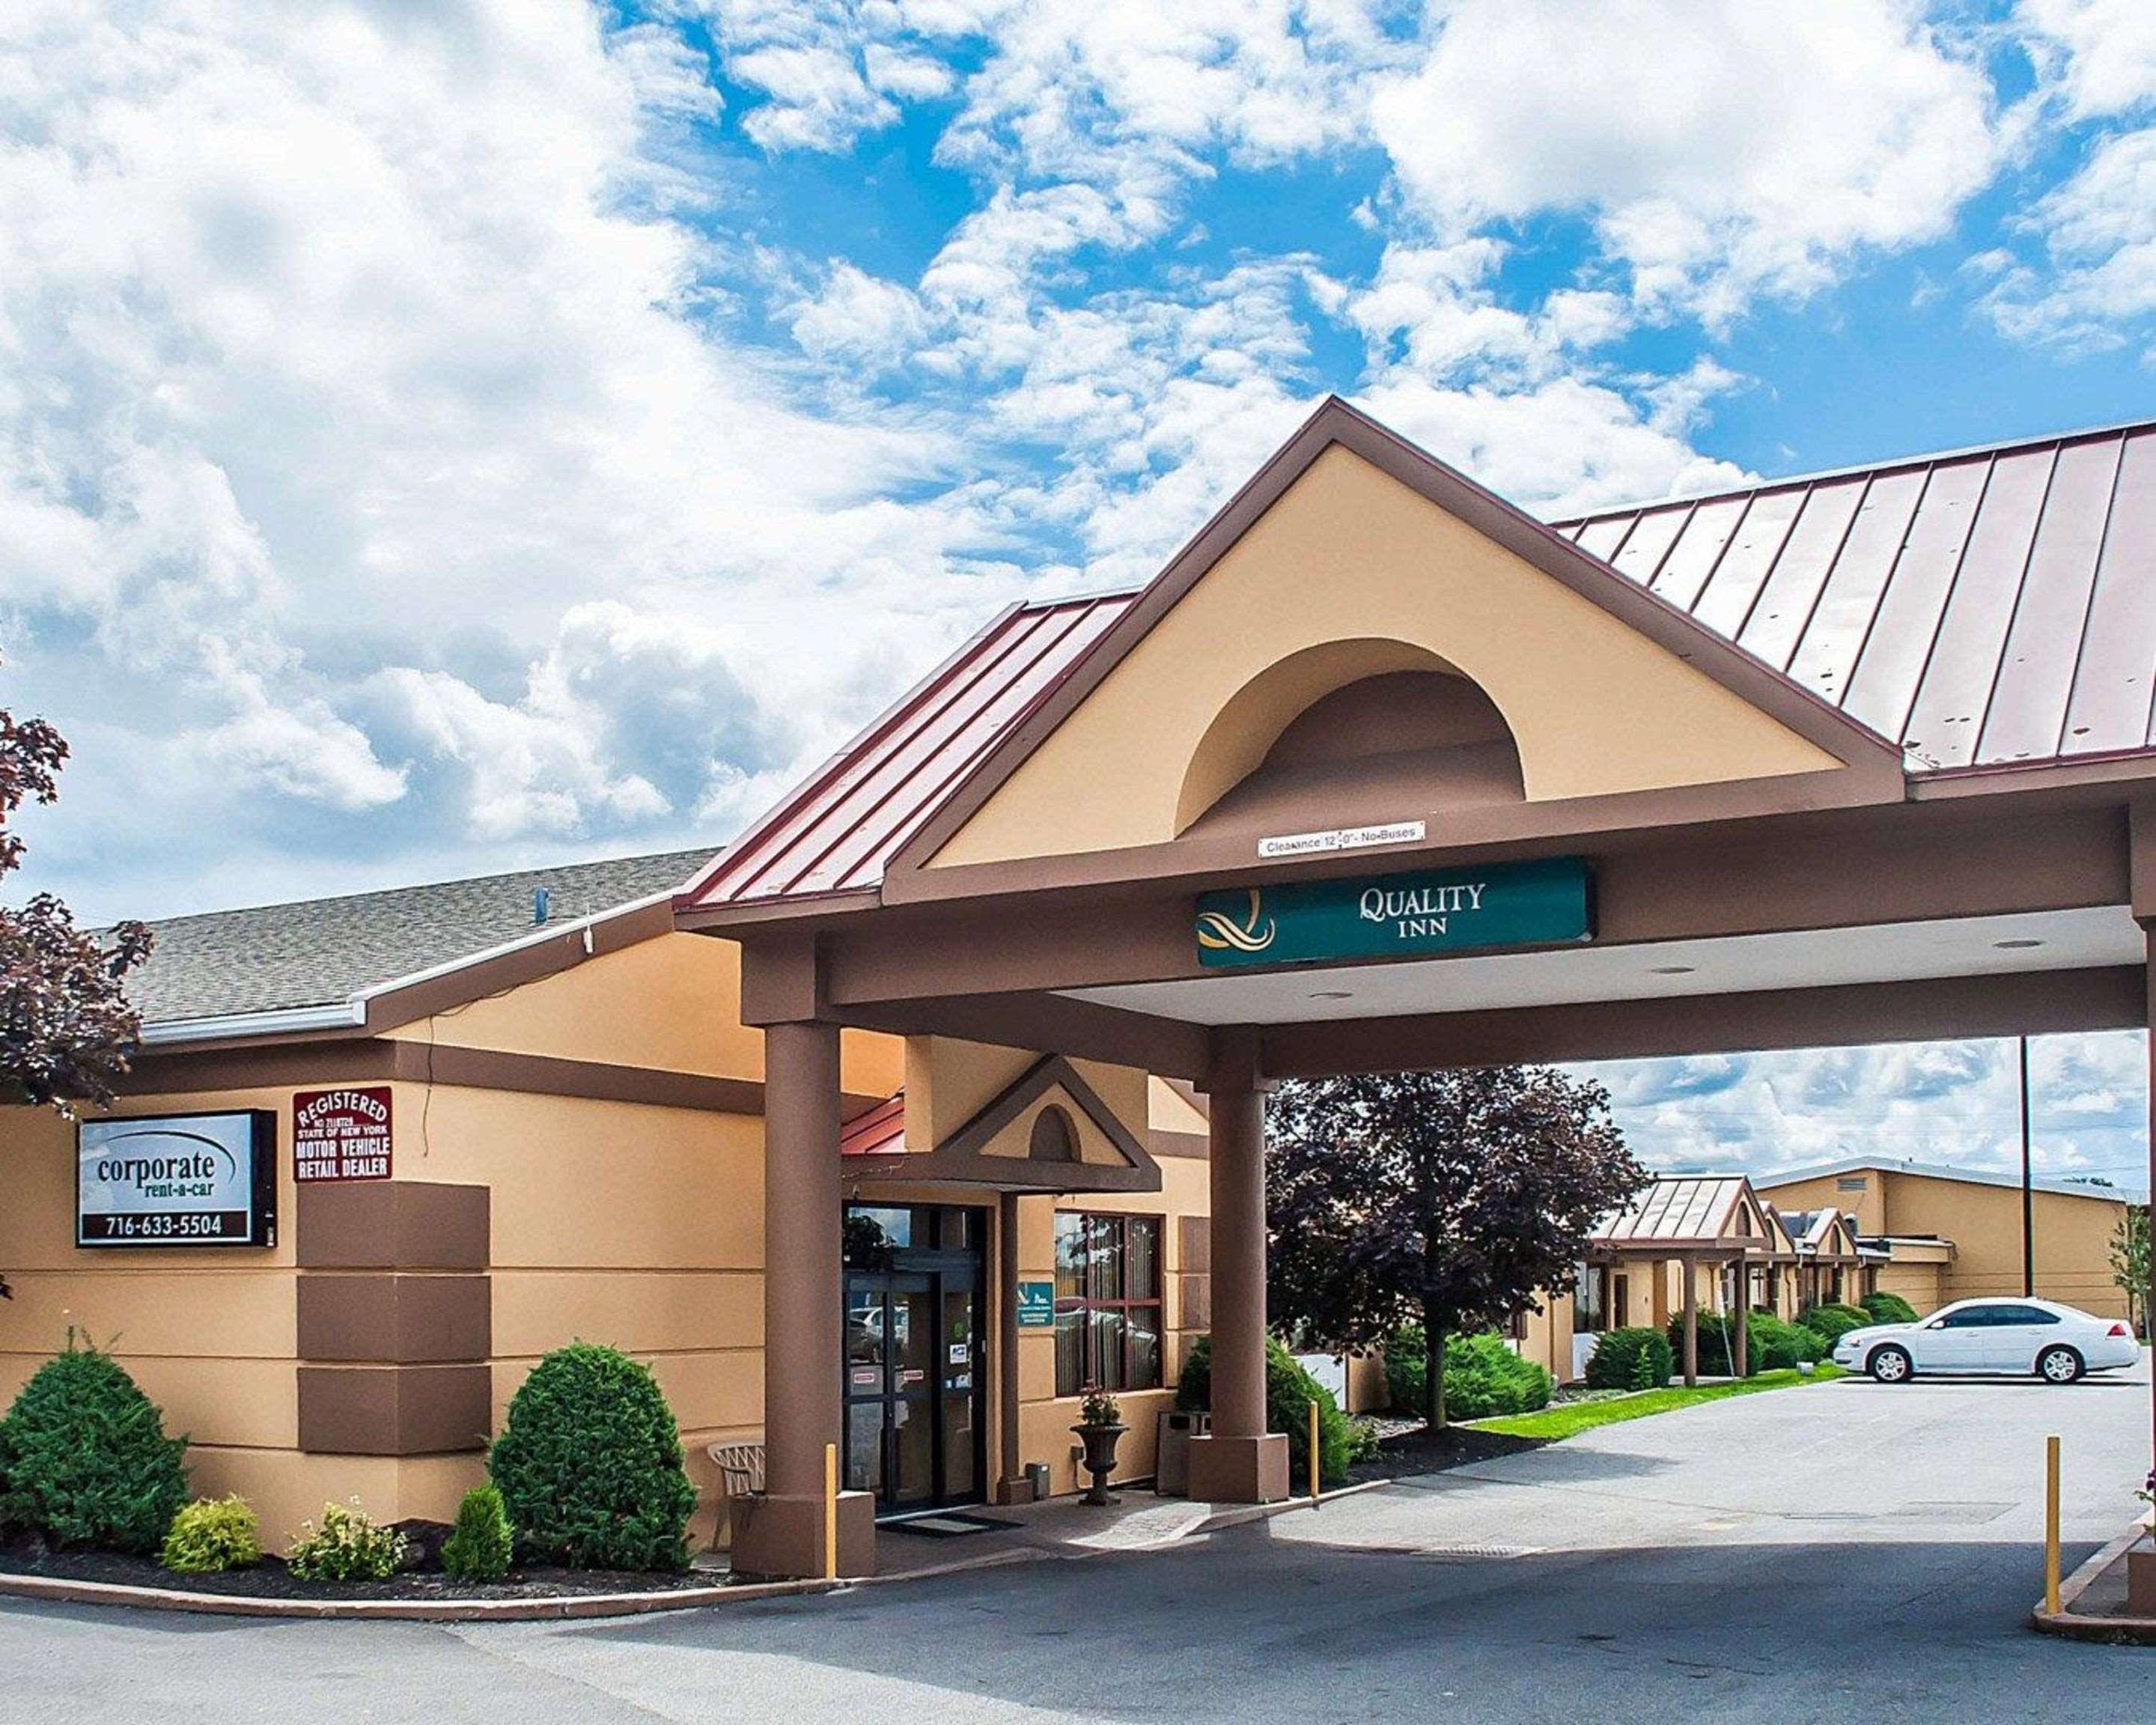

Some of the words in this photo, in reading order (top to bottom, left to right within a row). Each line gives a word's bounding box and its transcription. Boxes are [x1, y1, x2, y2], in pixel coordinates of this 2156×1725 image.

[1359, 883, 1486, 922] QUALITY
[1398, 918, 1447, 937] INN
[297, 1092, 387, 1127] REGISTERED
[298, 1129, 324, 1139] STATE
[326, 1128, 338, 1137] OF
[341, 1127, 361, 1137] NEW
[362, 1125, 387, 1135] YORK
[296, 1140, 337, 1159] MOTOR
[341, 1137, 390, 1156] VEHICLE
[97, 1150, 215, 1189] corporate
[299, 1160, 339, 1178] RETAIL
[342, 1157, 387, 1176] DEALER
[144, 1182, 215, 1198] rent-a-car
[106, 1214, 222, 1235] 716-633-5504
